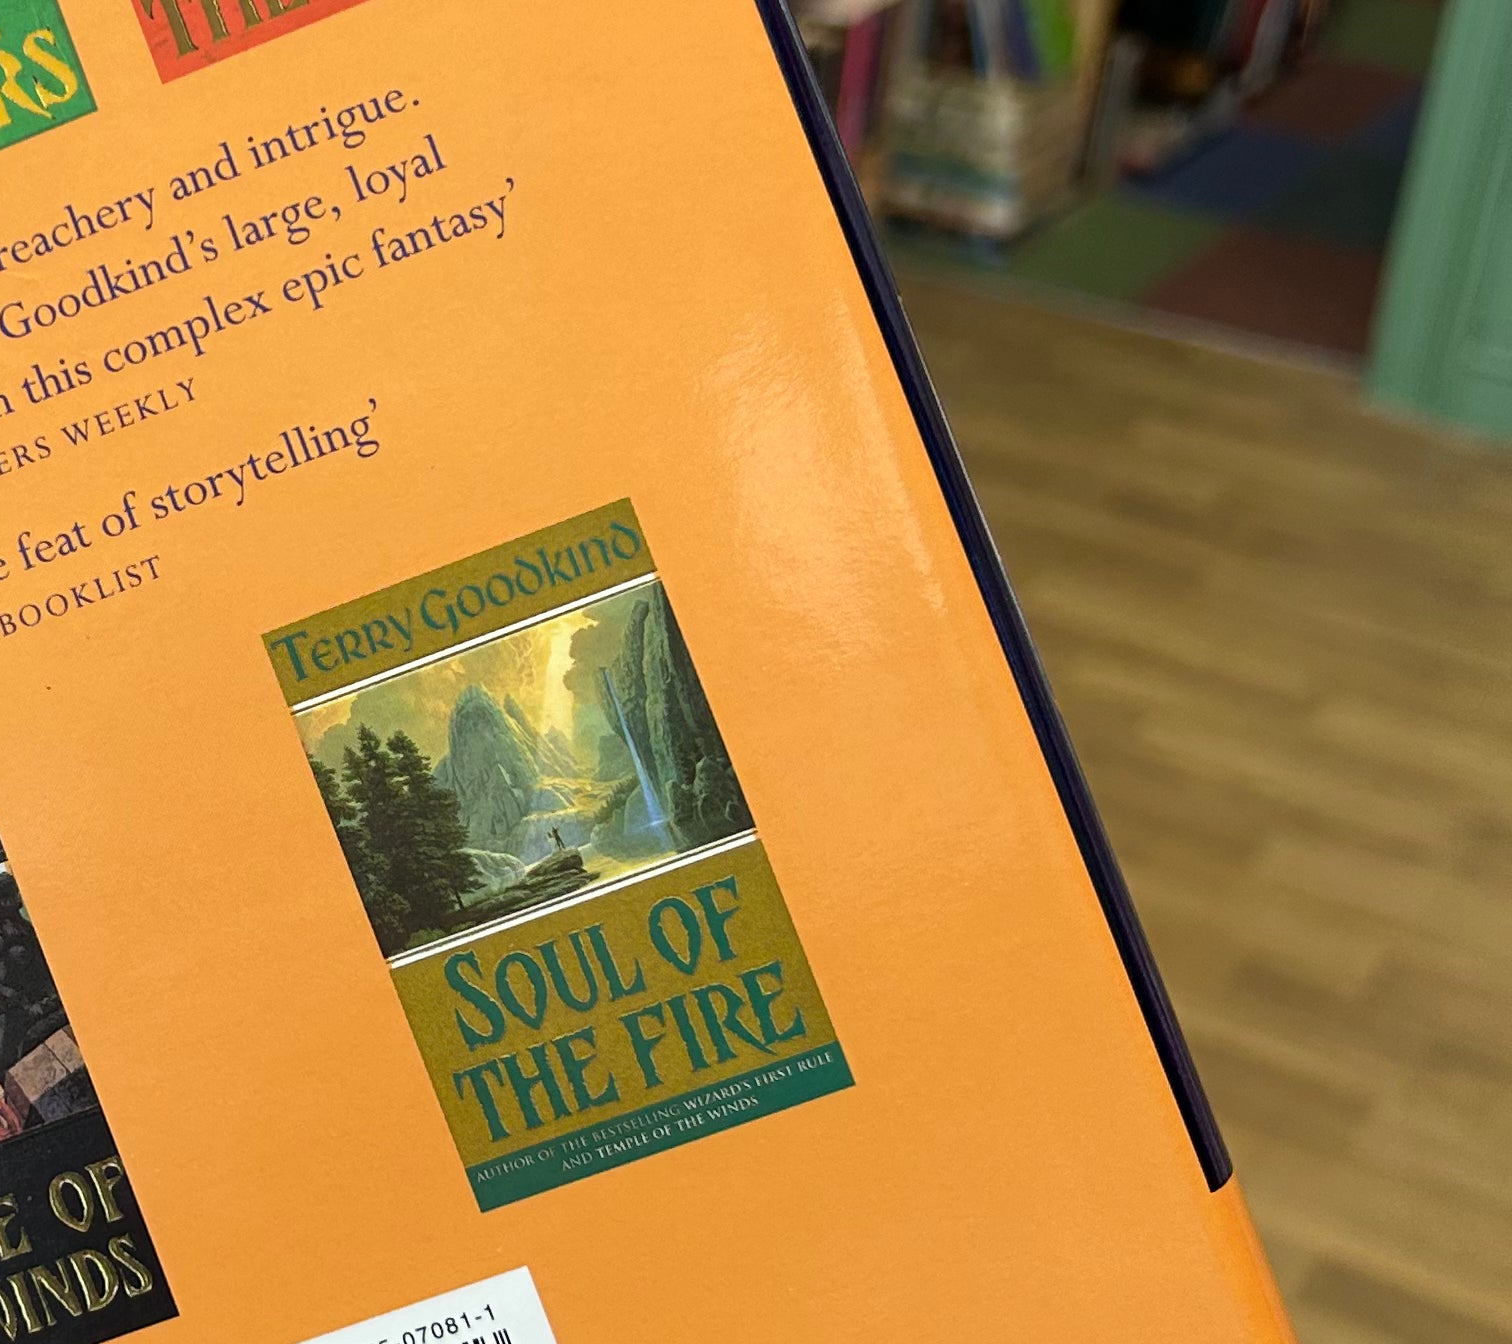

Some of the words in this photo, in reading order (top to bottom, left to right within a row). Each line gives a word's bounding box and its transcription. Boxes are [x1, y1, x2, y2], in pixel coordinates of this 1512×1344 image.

[172, 143, 241, 202] and
[247, 88, 421, 171] intrigue.
[223, 194, 342, 253] large,
[345, 133, 447, 204] loyal
[22, 358, 92, 404] this
[103, 288, 272, 374] complex
[282, 247, 364, 312] epic
[61, 377, 198, 448] WEEKLY
[17, 524, 92, 573] feat
[101, 491, 141, 540] of
[444, 923, 646, 1052] SOUL
[648, 874, 739, 976] OF
[453, 1026, 619, 1143] THE
[620, 960, 807, 1089] FIRE
[477, 1156, 535, 1183] AUTHOR
[538, 1146, 555, 1161] OF
[561, 1136, 587, 1152] THE
[592, 1104, 680, 1143] BESTSELLING
[683, 1079, 752, 1110] WIZARD'S
[754, 1065, 792, 1087] FIRST
[797, 1051, 833, 1072] RULE
[562, 1151, 592, 1171] AND
[595, 1132, 649, 1159] TEMPLE
[653, 1123, 672, 1139] OF
[677, 1112, 705, 1131] THE
[707, 1096, 759, 1120] WINDS
[49, 1156, 125, 1233] OF
